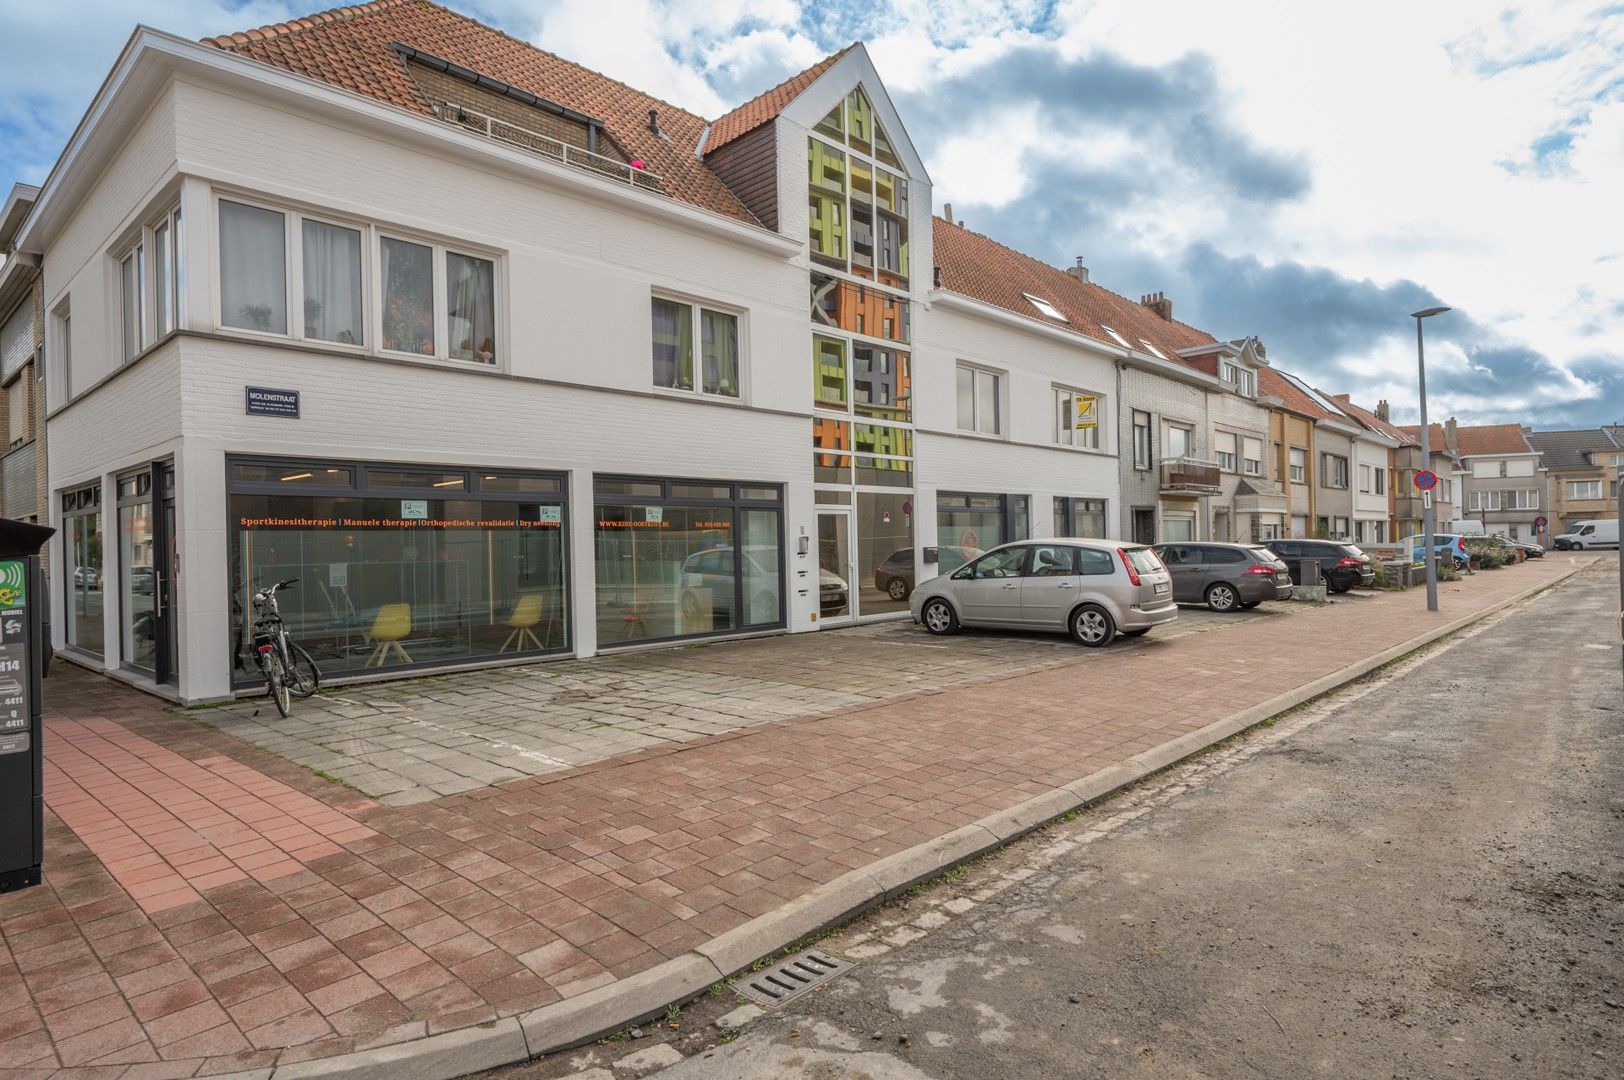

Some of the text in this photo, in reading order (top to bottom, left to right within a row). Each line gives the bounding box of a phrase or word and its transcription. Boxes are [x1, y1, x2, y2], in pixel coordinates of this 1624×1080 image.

[250, 392, 296, 402] MOLENSTRAAT
[240, 517, 337, 527] Sportkinesitherapie
[343, 518, 380, 526] Manuele
[382, 518, 416, 528] therapie
[421, 519, 475, 528] Orthopedische
[520, 520, 532, 528] Dry
[5, 696, 23, 705] 4411
[6, 719, 24, 728] 4411
